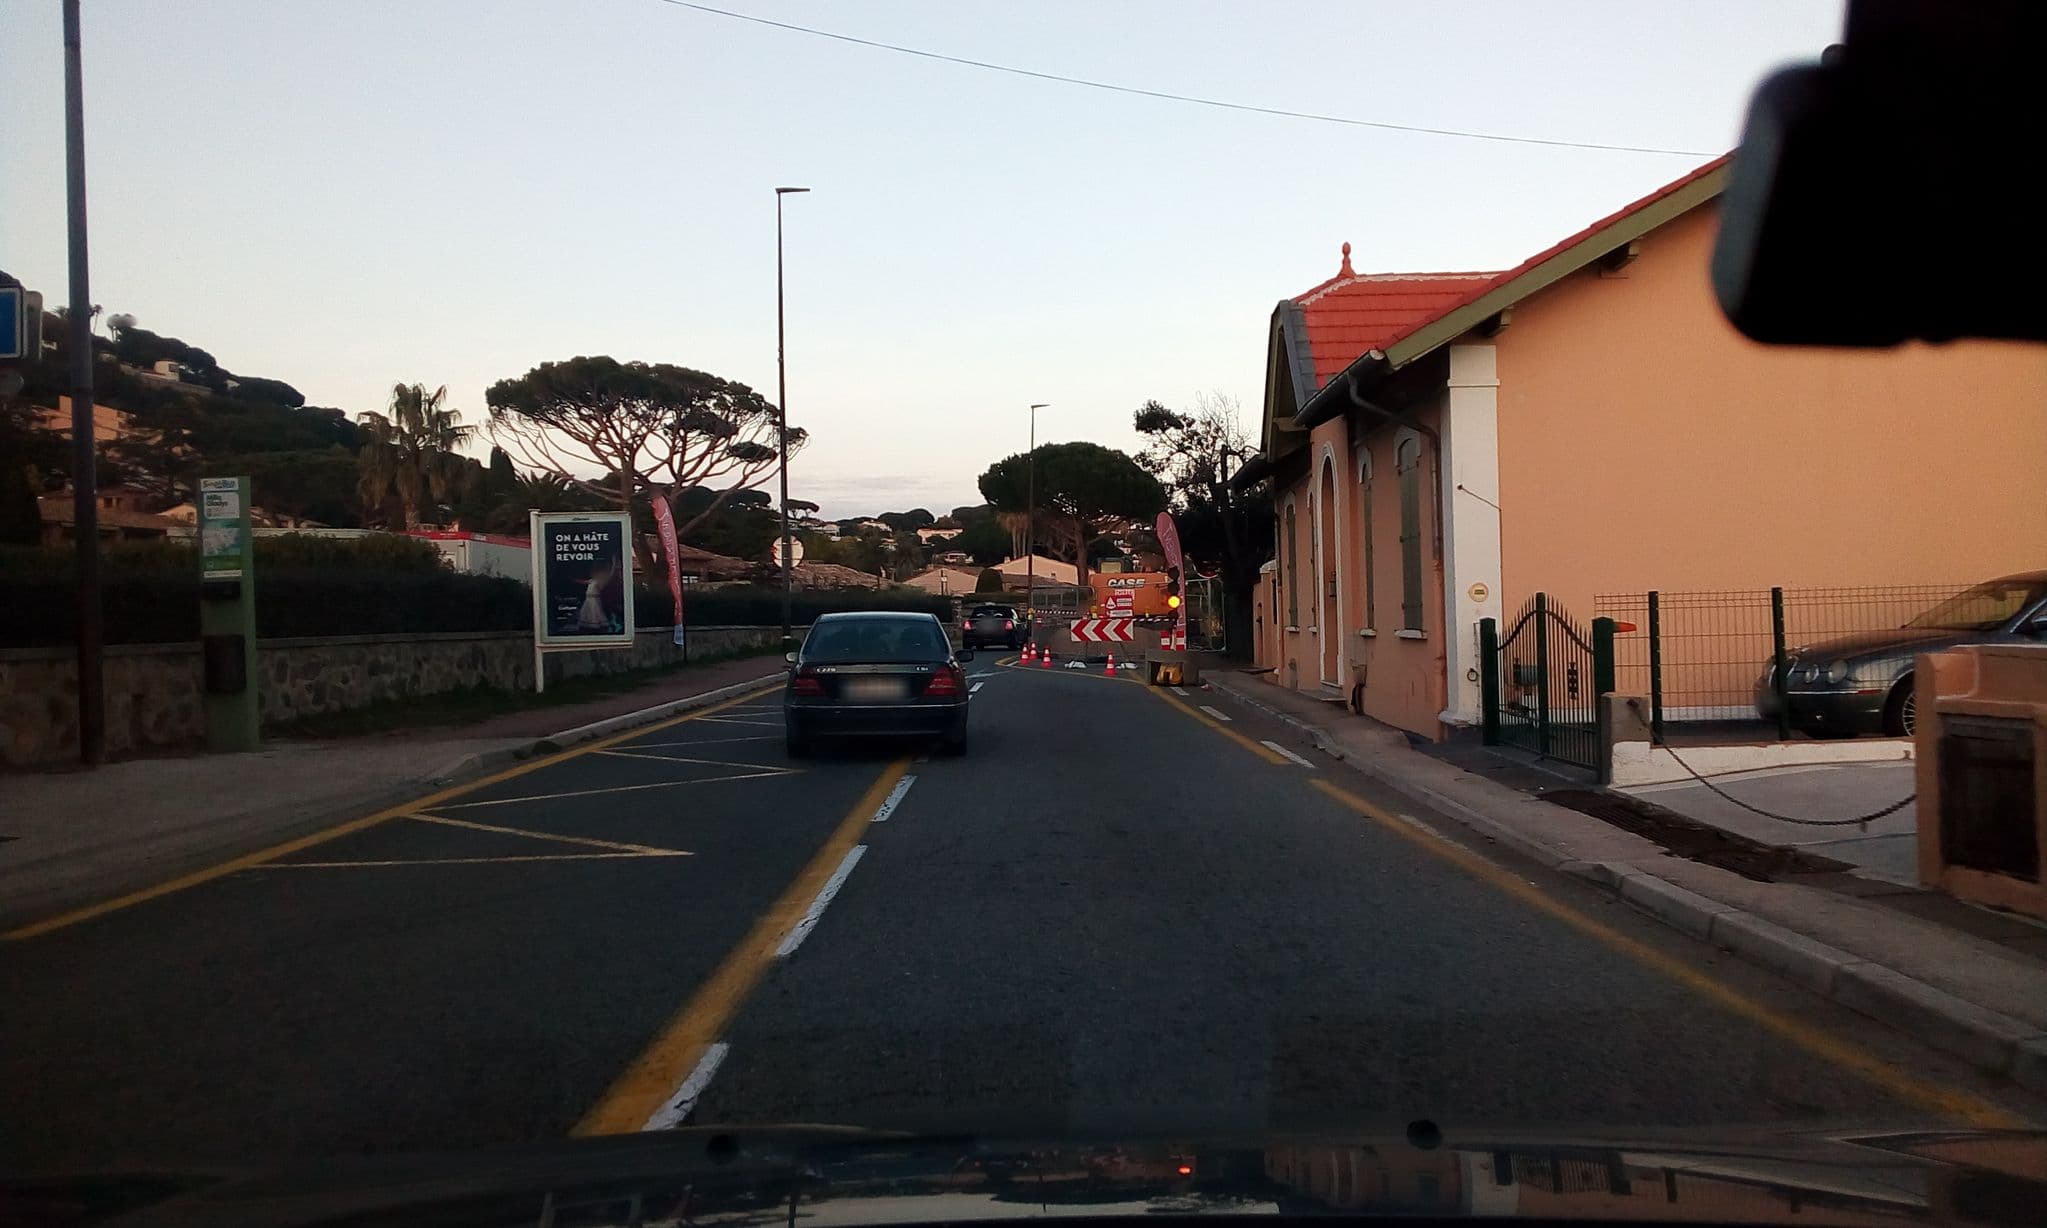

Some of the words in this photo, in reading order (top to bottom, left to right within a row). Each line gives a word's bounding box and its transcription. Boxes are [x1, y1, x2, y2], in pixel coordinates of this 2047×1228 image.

[555, 534, 571, 542] ON
[573, 534, 581, 542] A
[583, 531, 609, 541] HÂTE
[556, 543, 569, 551] DE
[572, 543, 600, 551] VOUS
[556, 552, 594, 561] REVOIR
[1108, 578, 1145, 588] CASE
